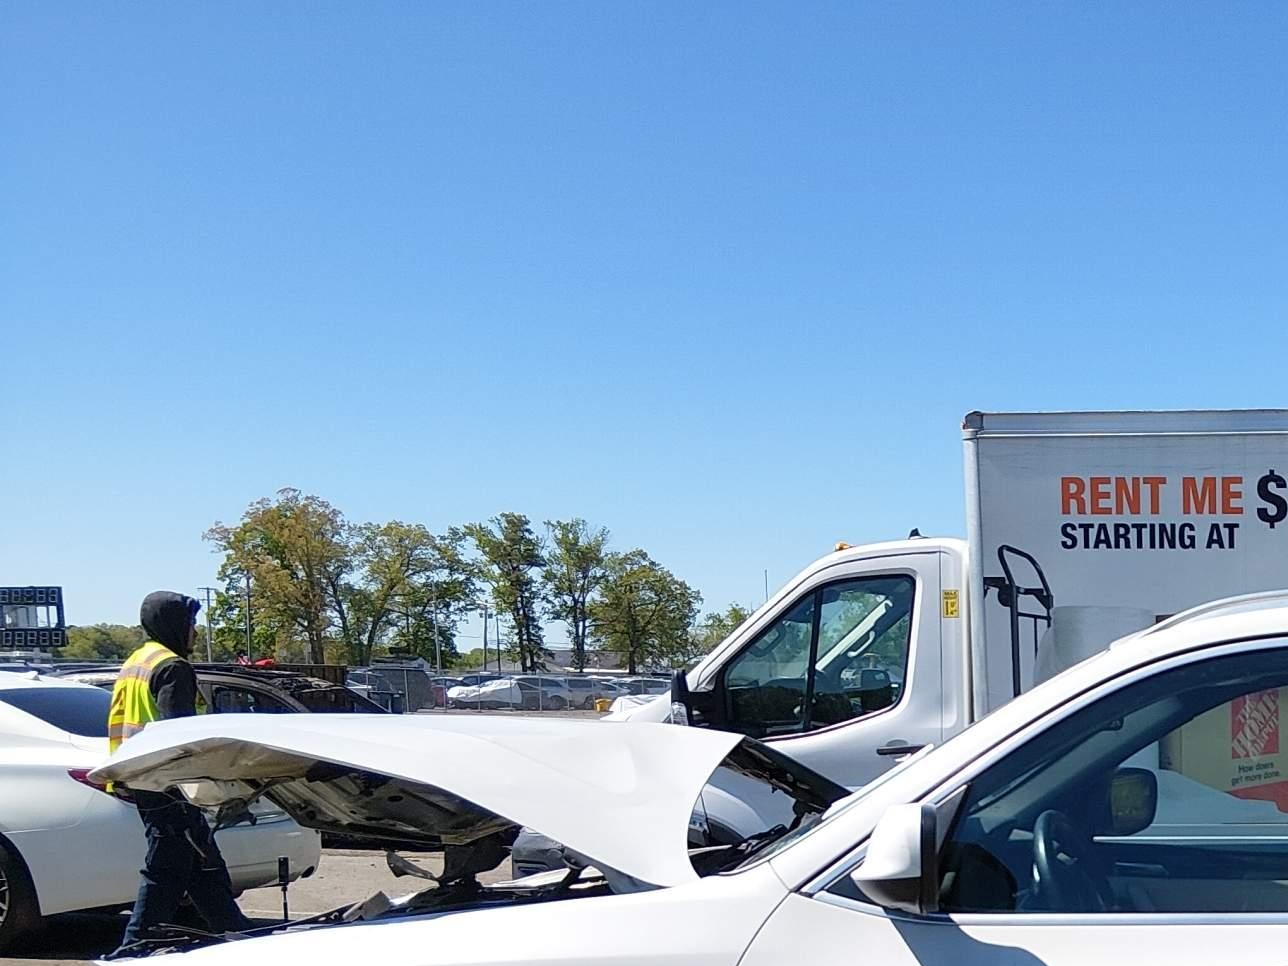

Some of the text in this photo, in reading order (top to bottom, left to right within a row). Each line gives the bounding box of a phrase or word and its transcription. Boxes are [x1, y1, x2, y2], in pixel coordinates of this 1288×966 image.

[1060, 476, 1244, 515] RENT ME
[1060, 522, 1240, 550] STARTING AT
[1232, 691, 1279, 757] HOME
